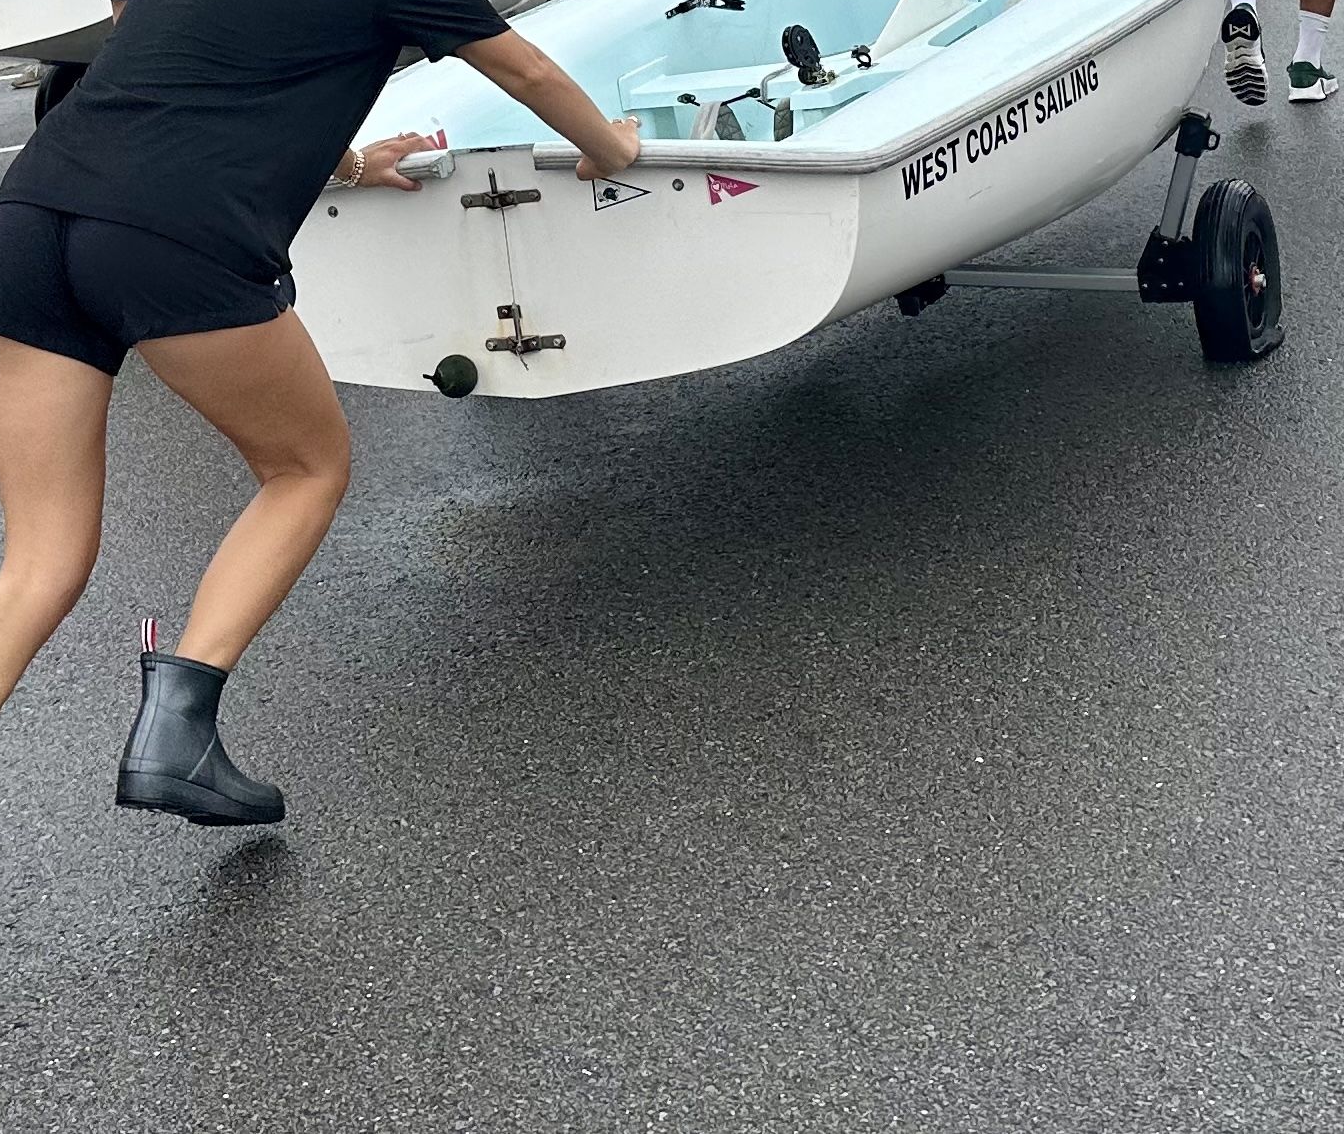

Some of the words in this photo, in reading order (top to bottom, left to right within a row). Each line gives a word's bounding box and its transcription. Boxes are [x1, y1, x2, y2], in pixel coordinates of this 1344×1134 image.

[901, 137, 960, 201] WEST
[965, 98, 1029, 164] COAST
[1033, 59, 1099, 125] SAILING
